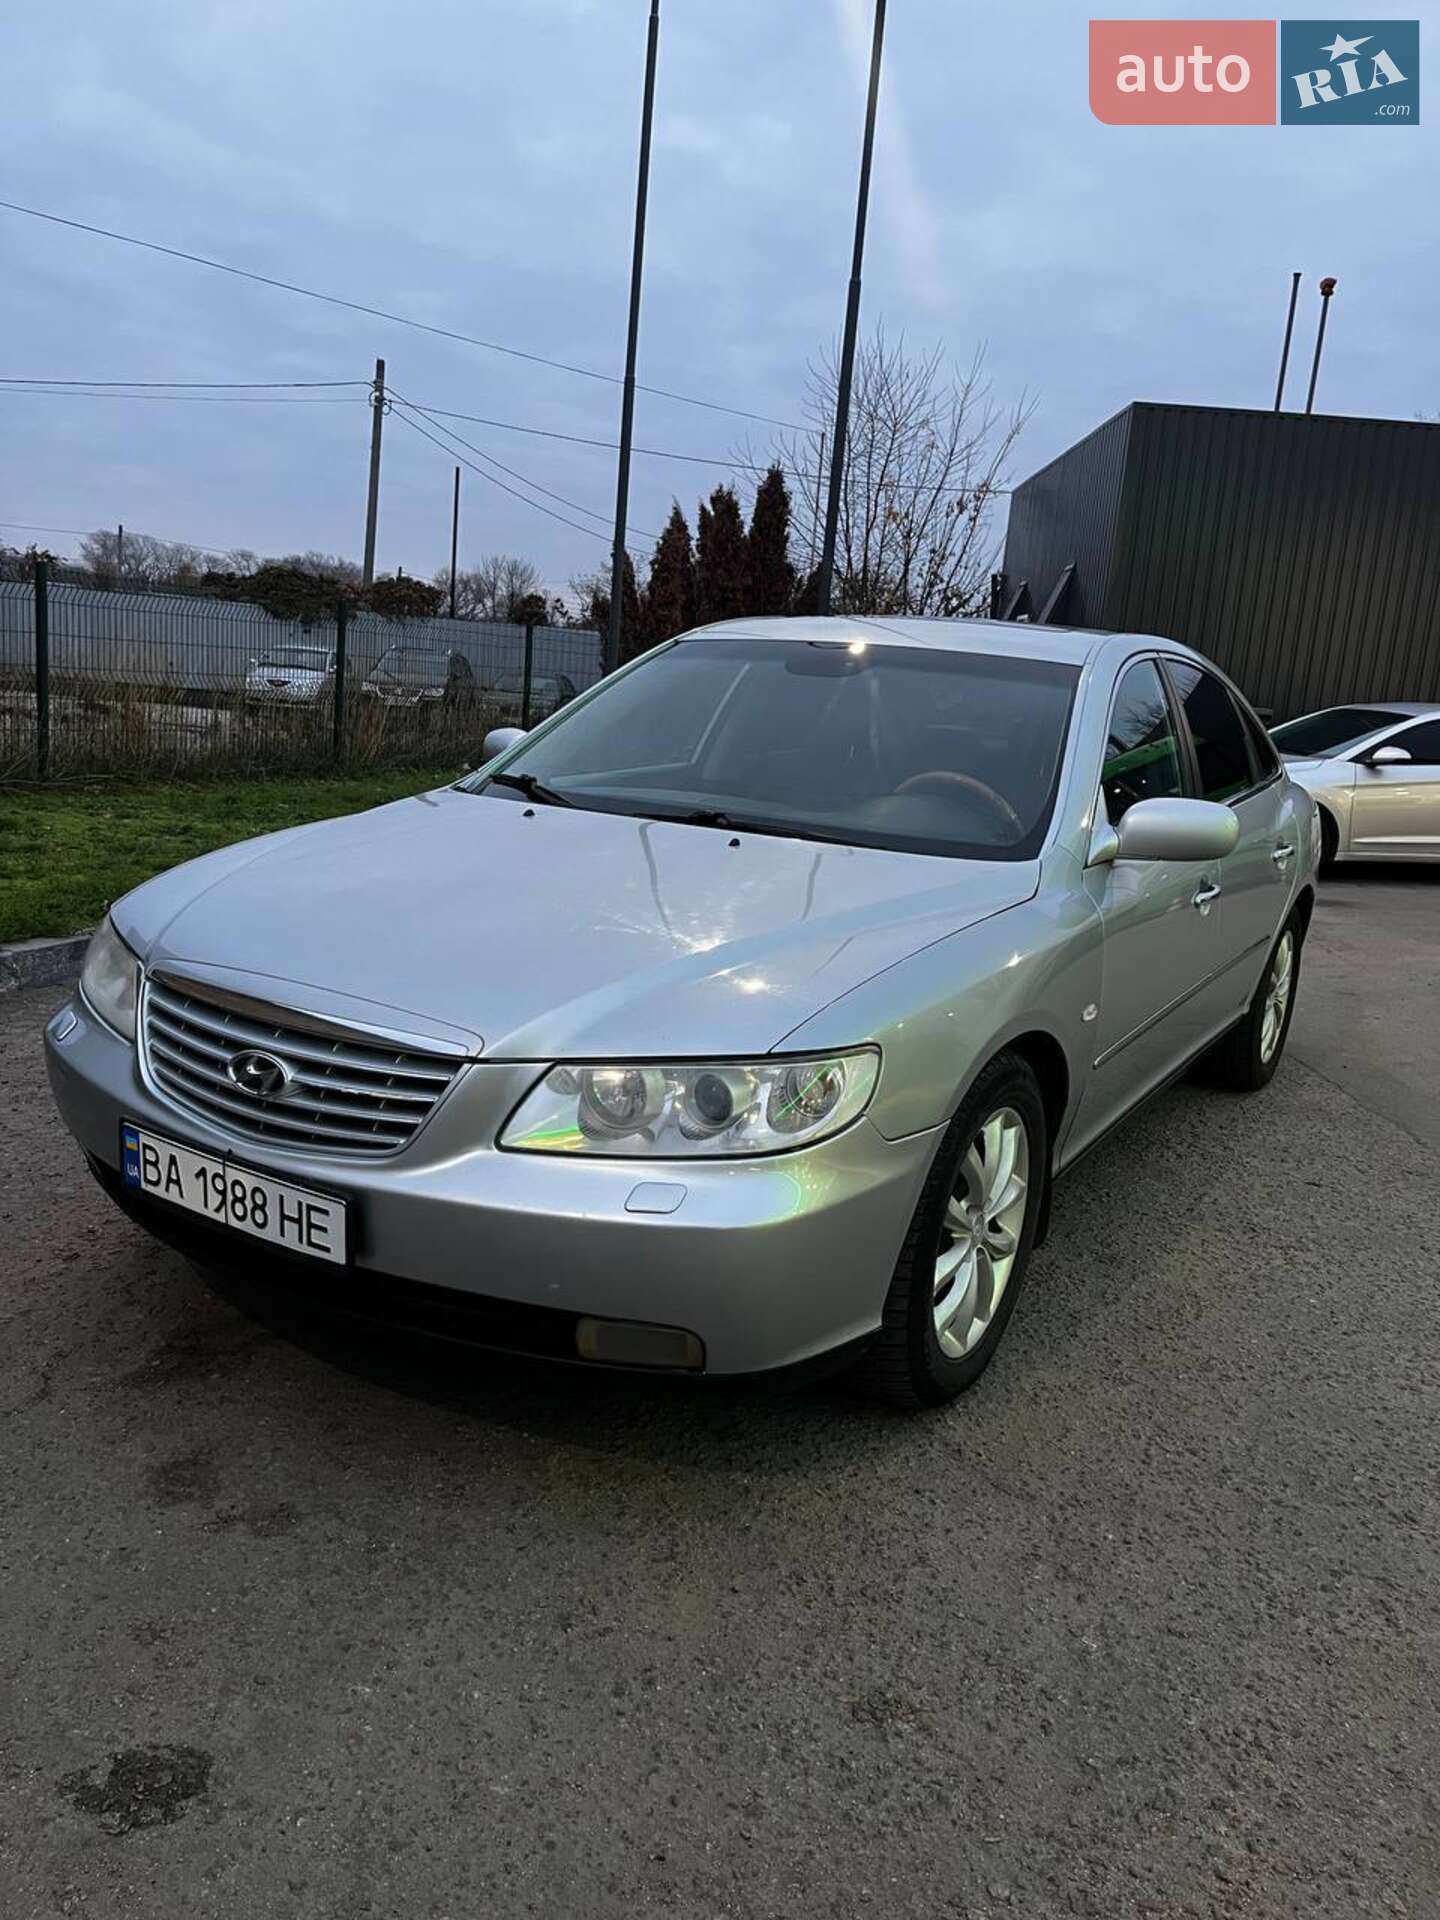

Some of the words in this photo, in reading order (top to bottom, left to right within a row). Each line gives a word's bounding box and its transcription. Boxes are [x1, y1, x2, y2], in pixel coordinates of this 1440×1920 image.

[127, 1163, 140, 1178] UA
[141, 1141, 184, 1199] BA
[194, 1166, 269, 1230] 1988
[279, 1193, 331, 1253] HE
